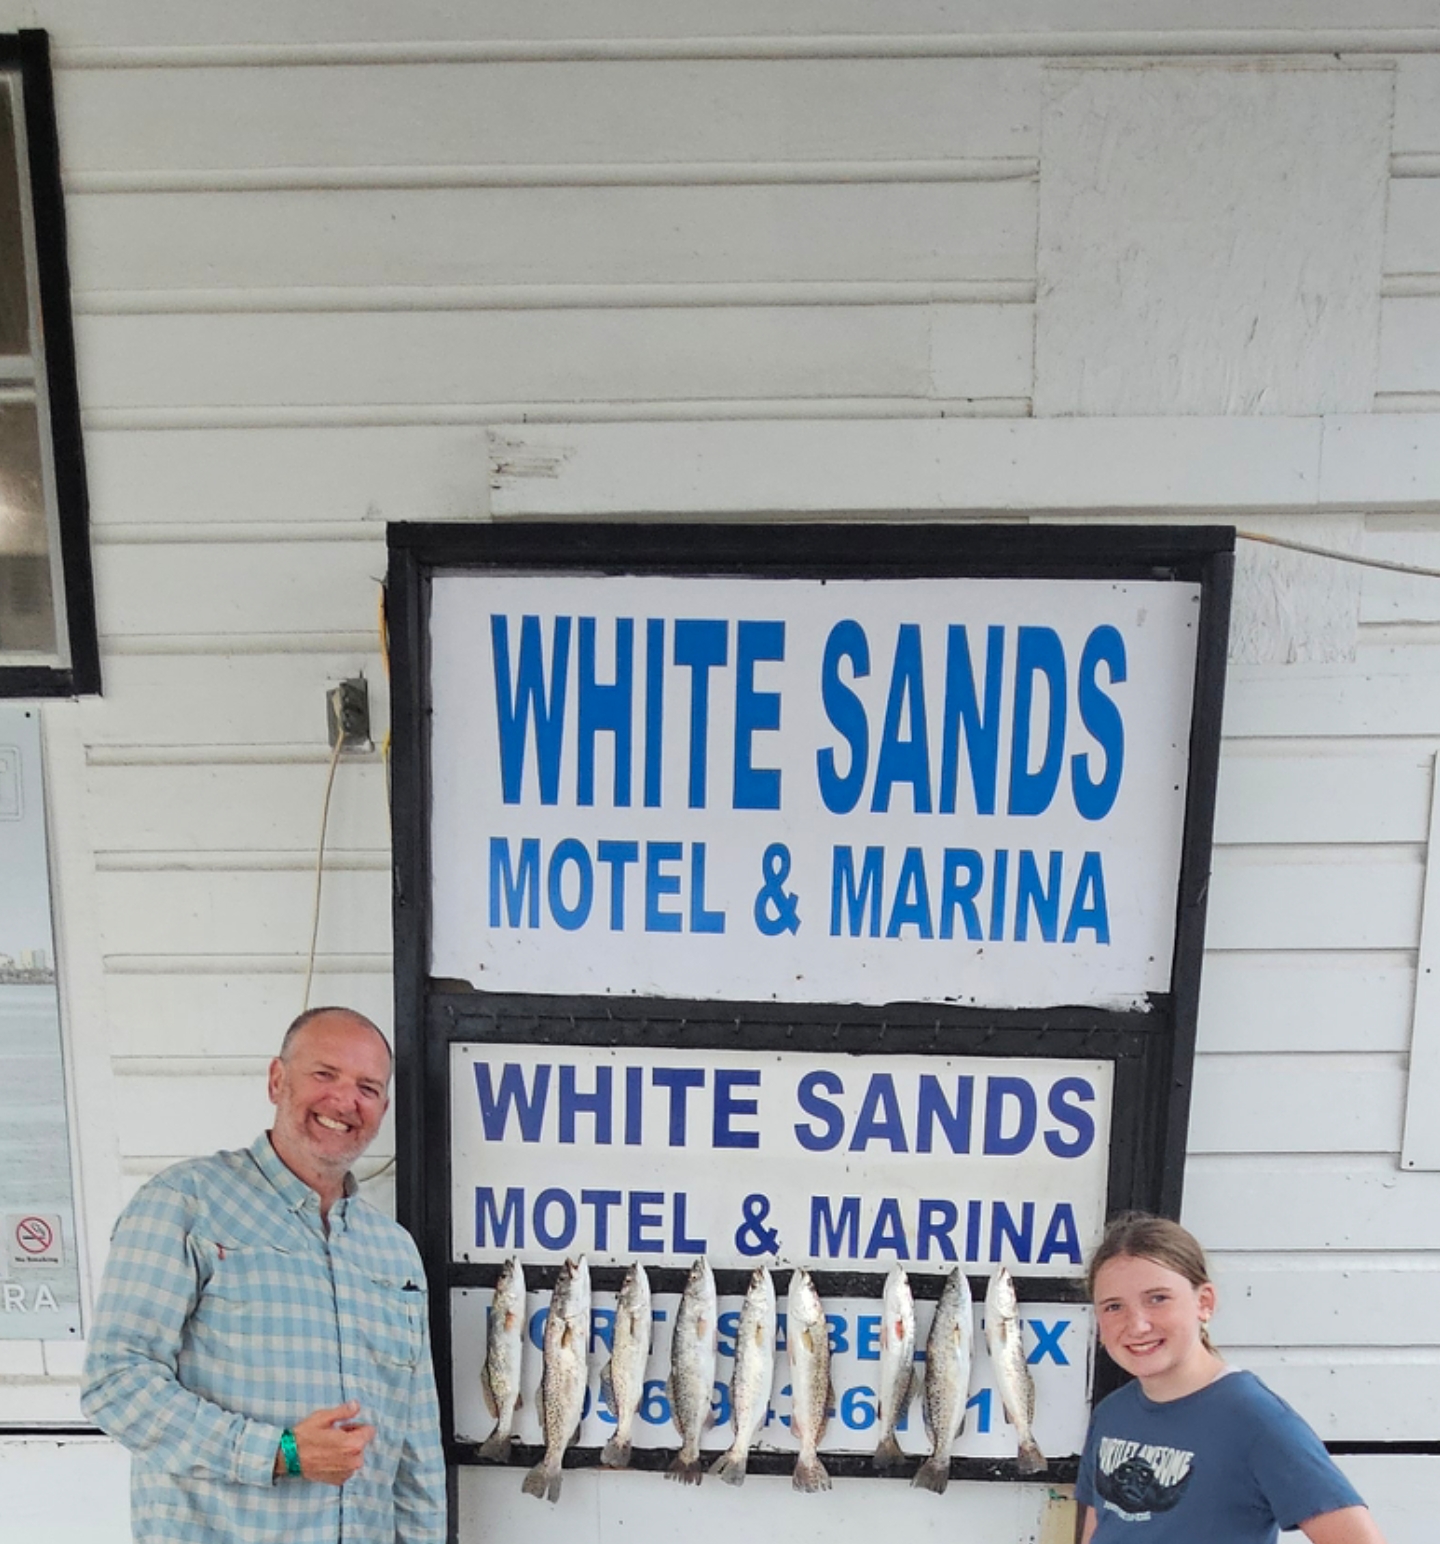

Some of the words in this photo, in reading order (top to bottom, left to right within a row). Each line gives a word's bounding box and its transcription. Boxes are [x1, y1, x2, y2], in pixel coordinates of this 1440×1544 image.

[490, 613, 786, 811] WHITE
[815, 618, 1129, 822] SANDS
[488, 836, 726, 936] MOTEL
[754, 842, 801, 938] &
[829, 845, 1112, 946] MARINA
[474, 1062, 761, 1149] WHITE
[794, 1070, 1096, 1159] SANDS
[474, 1187, 707, 1255] MOTEL
[735, 1193, 780, 1256] &
[809, 1196, 1083, 1264] MARINA
